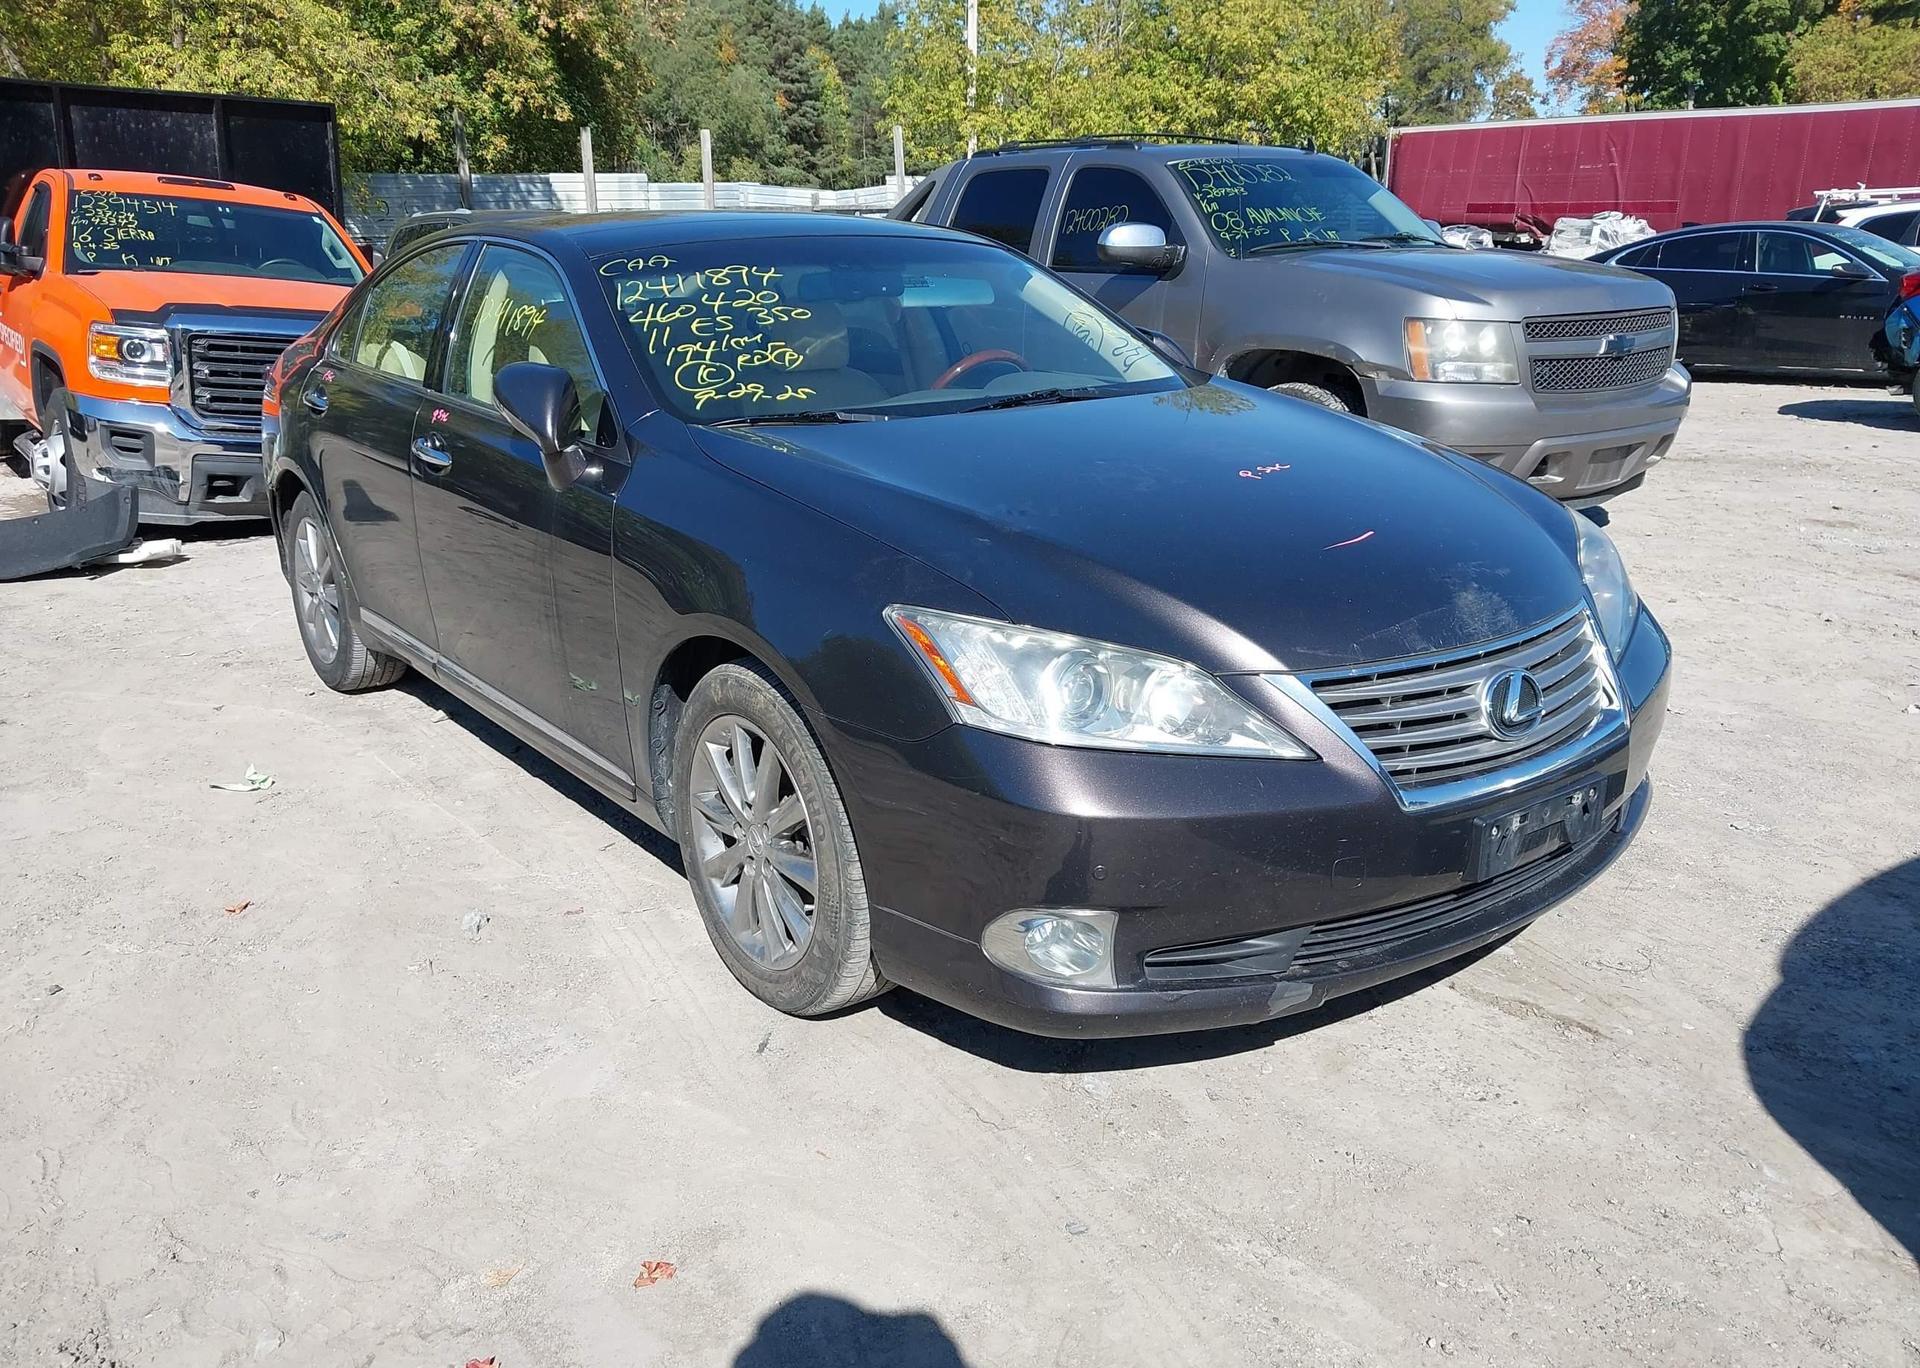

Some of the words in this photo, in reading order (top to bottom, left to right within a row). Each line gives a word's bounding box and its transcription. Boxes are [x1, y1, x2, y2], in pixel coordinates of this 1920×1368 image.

[75, 194, 178, 216] 12394514
[1211, 210, 1245, 231] 08
[1245, 207, 1327, 225] AVALANCHE
[73, 226, 92, 242] 16
[73, 242, 120, 250] 9-4-25
[599, 255, 678, 276] CAA
[616, 265, 783, 310] 12411894
[470, 294, 547, 341] 12411894
[629, 302, 697, 332] 460
[702, 289, 779, 314] 420
[649, 326, 671, 354] 11
[691, 315, 734, 336] ES
[746, 307, 812, 325] 350
[666, 340, 722, 366] 194
[693, 382, 817, 410] 9-29-25
